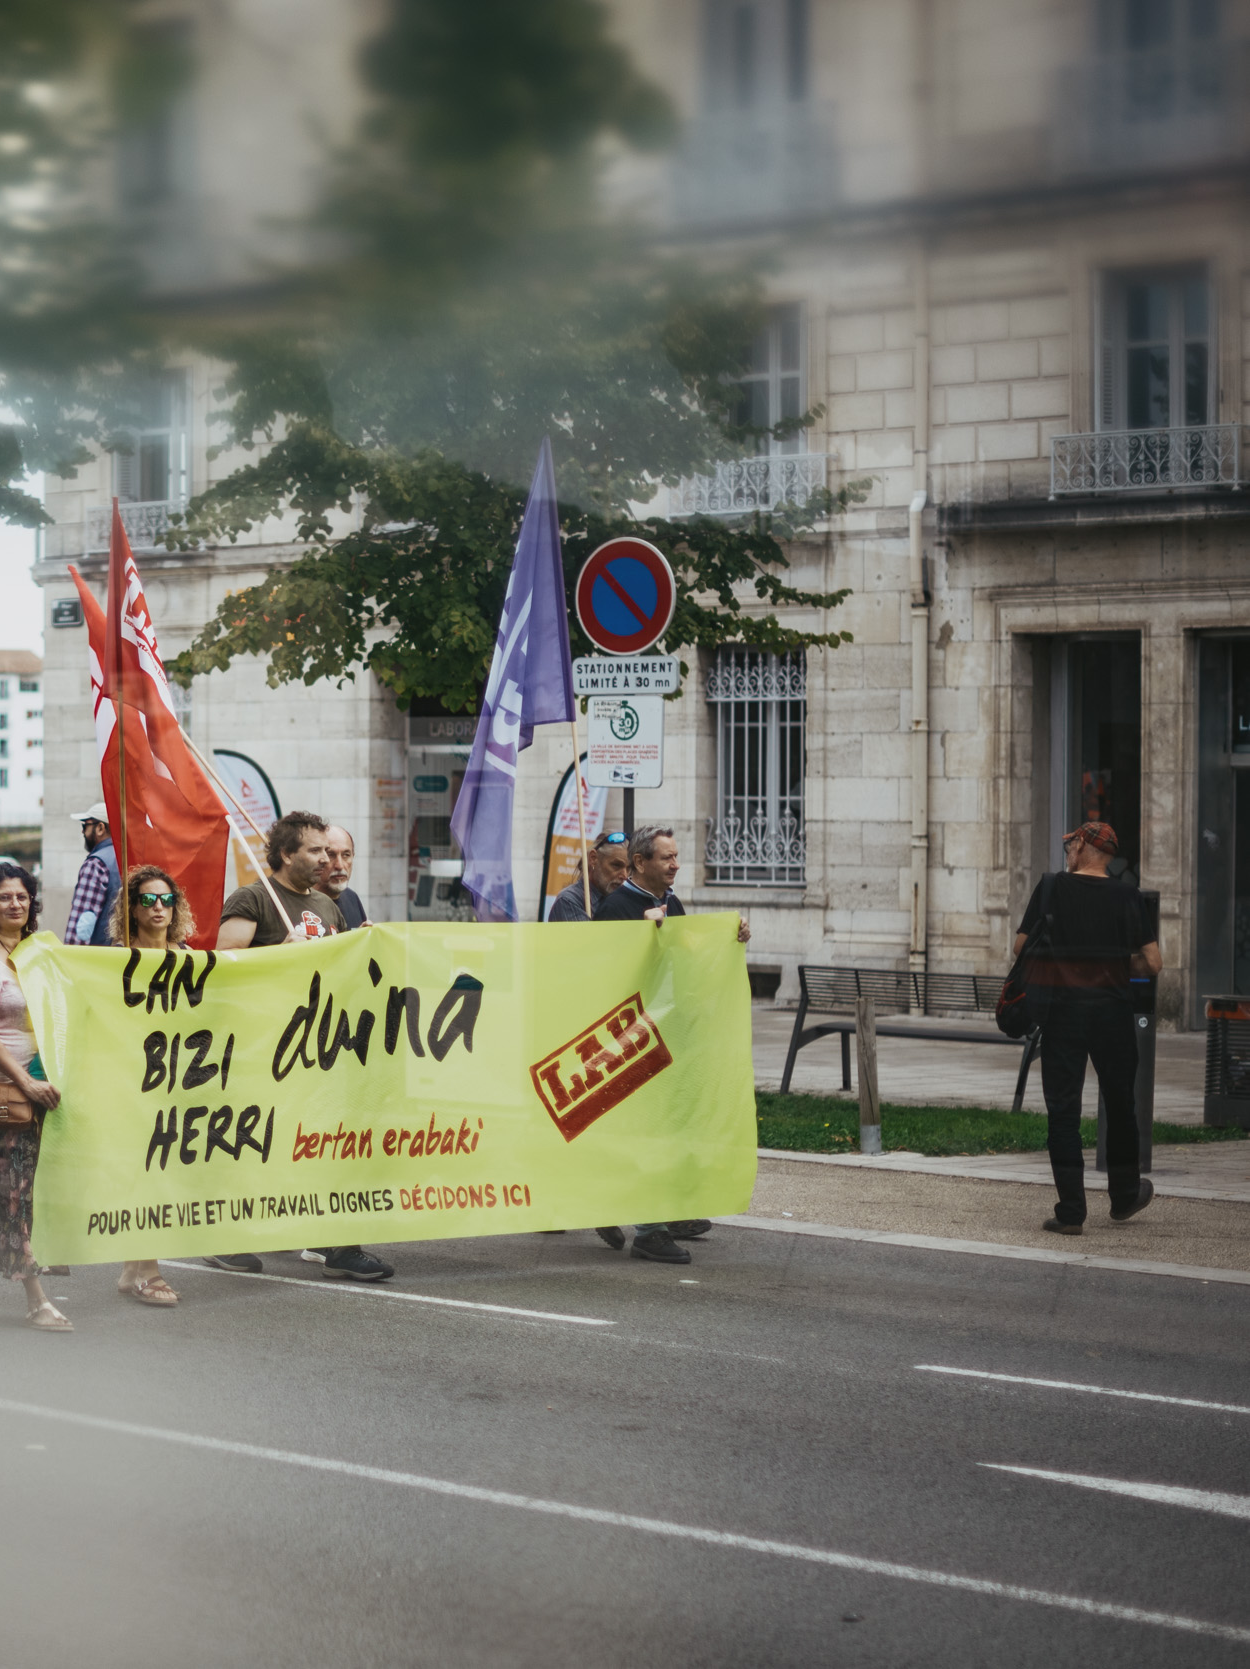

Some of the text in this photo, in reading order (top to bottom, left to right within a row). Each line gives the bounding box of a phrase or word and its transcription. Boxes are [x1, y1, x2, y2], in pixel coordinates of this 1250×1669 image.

[576, 662, 673, 674] STATIONNEMENT
[579, 675, 670, 688] LIMITÉ À 30 mn
[619, 718, 632, 727] 30
[123, 948, 217, 1014] LAN
[272, 957, 484, 1082] duina
[141, 1029, 235, 1094] BIZI
[539, 1007, 650, 1112] LAB
[145, 1105, 275, 1172] HERRI
[292, 1112, 484, 1162] bertan erabaki
[87, 1183, 531, 1236] POUR UNE VIE ET UN TRAVAIL DIGNES DÉCIDONS ICI
